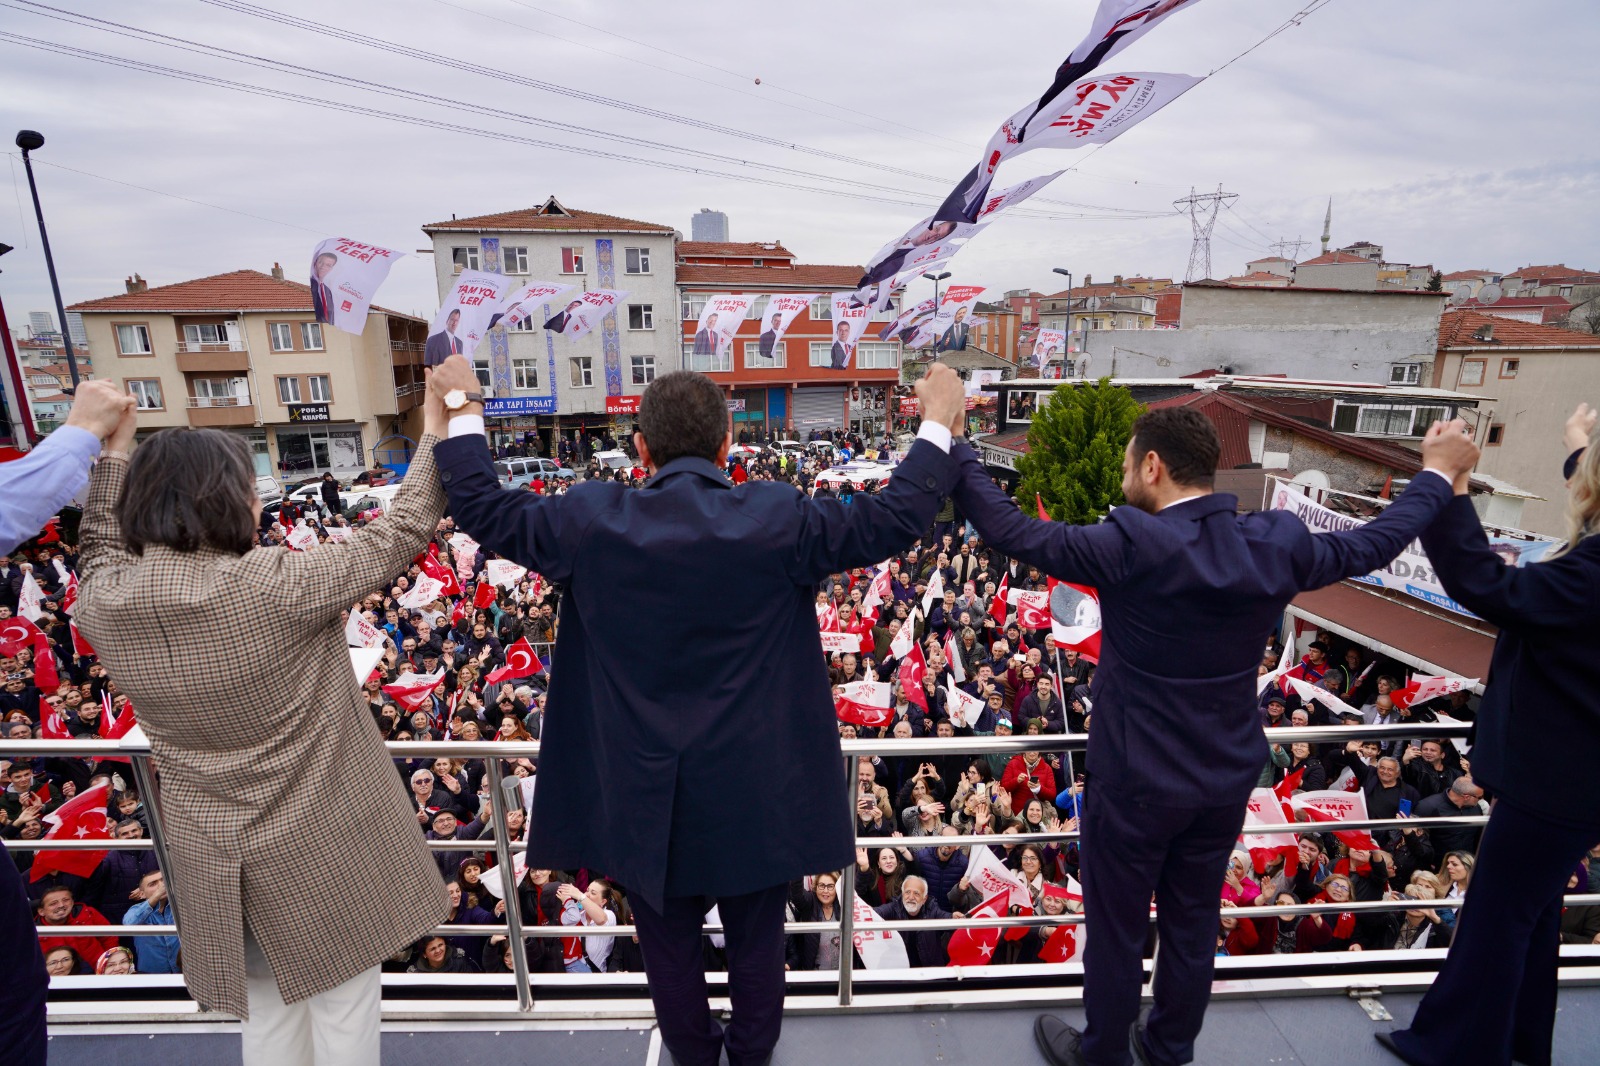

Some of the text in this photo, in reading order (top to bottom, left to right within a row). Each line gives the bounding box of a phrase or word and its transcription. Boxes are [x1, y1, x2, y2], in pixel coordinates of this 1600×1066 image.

[335, 244, 376, 264] İLERİ
[458, 284, 496, 300] TAM YOL
[460, 293, 485, 307] İLERİ
[732, 300, 748, 309] YOL
[842, 307, 867, 318] İLERİ
[507, 401, 523, 409] YAPI
[526, 398, 552, 410] İNŞAAT
[607, 405, 632, 413] Börek
[992, 453, 1010, 467] KRAL
[1431, 595, 1452, 608] PAŞA
[357, 620, 370, 629] TAM
